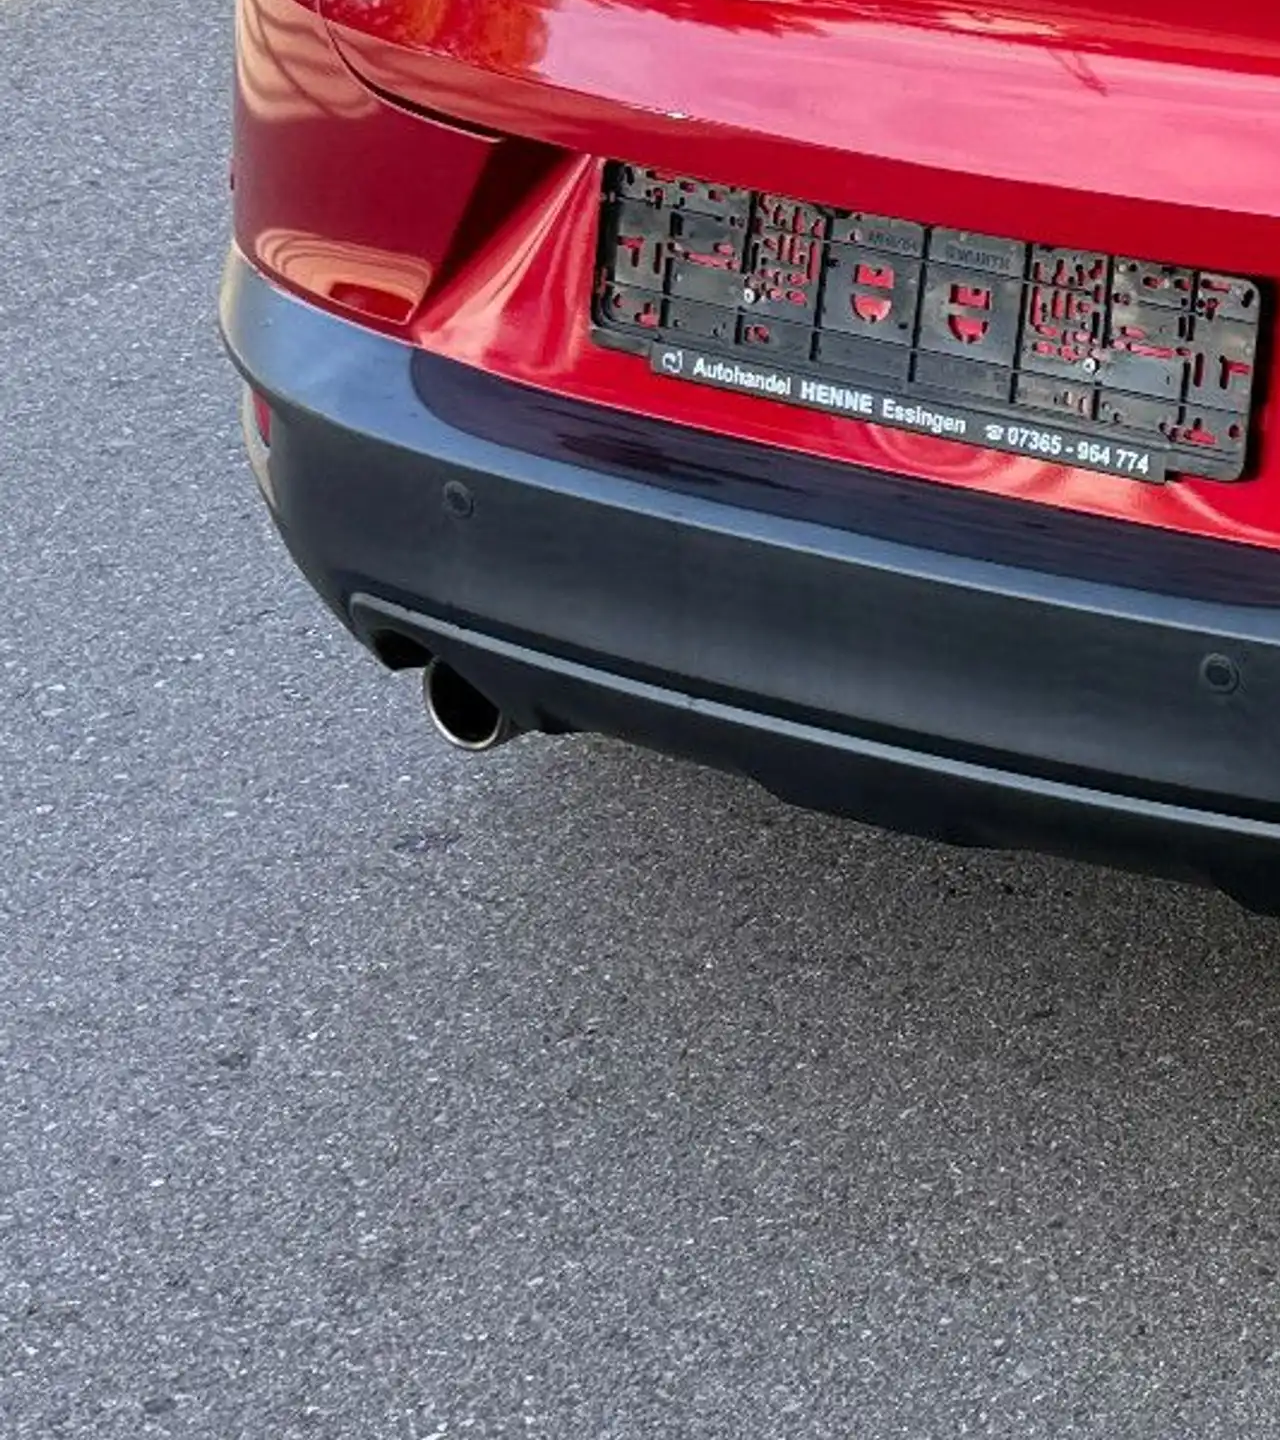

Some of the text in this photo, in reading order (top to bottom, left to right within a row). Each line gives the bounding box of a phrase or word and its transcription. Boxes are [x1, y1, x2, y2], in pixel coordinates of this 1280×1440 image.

[692, 357, 792, 396] Autohandel
[801, 380, 874, 415] HENNE
[882, 399, 967, 435] Essingen
[1007, 425, 1062, 456] 07365
[1077, 441, 1111, 466] 964
[1116, 448, 1150, 475] 774
